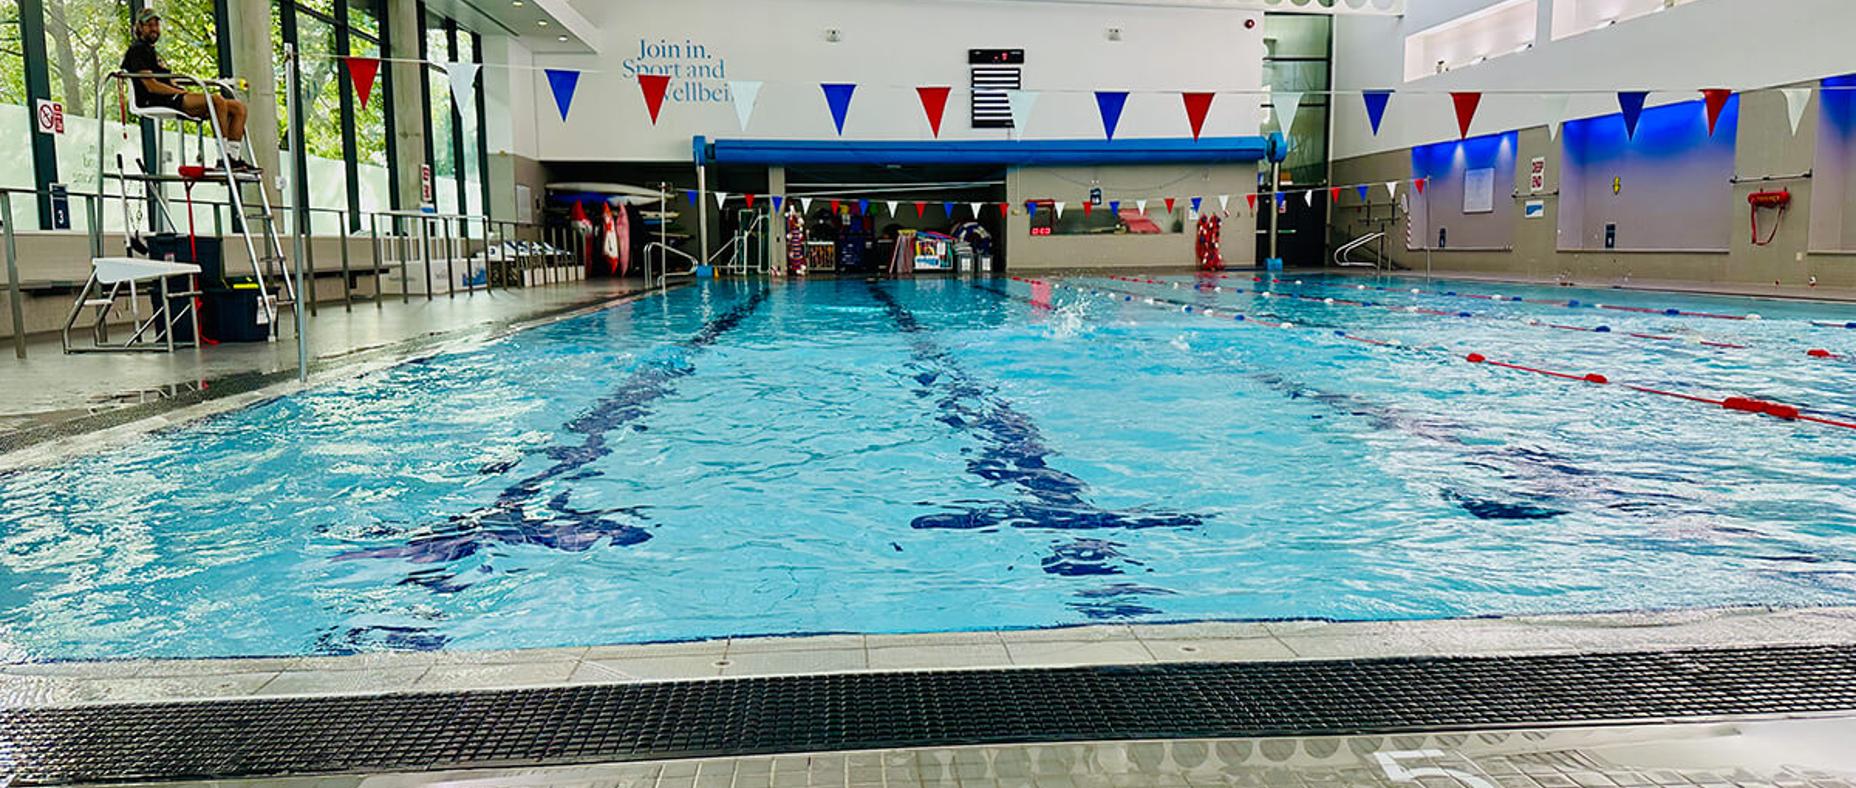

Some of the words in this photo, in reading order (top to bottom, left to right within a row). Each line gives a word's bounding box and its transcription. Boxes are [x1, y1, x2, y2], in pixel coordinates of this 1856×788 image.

[637, 39, 681, 60] Join
[686, 39, 711, 59] in.
[686, 58, 725, 79] and
[665, 81, 735, 103] ellbei
[58, 209, 65, 224] 3
